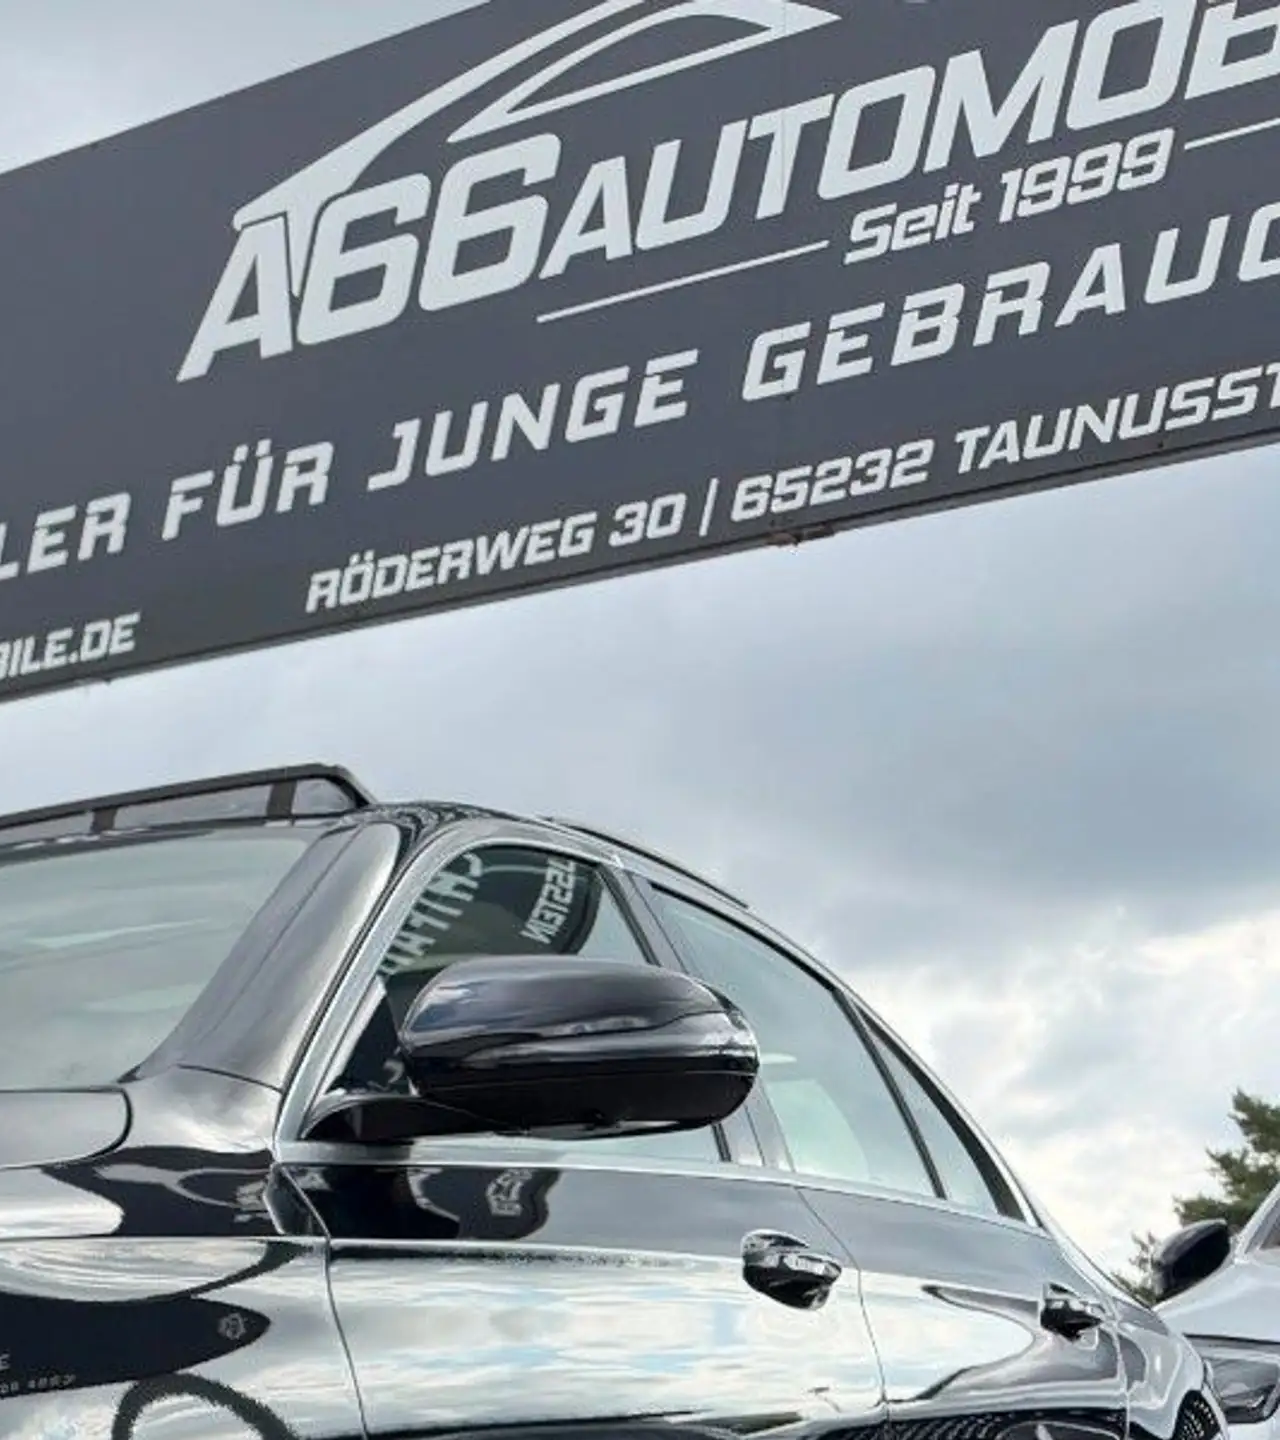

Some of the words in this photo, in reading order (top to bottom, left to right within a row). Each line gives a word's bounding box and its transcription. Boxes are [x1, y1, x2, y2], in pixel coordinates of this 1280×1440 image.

[844, 182, 982, 265] Seit
[998, 127, 1175, 224] 1999
[161, 438, 334, 541] FÜR
[367, 348, 699, 491] JUNGE
[305, 511, 598, 613] RÖDERWEG
[608, 493, 688, 547] 30
[731, 438, 936, 533] 65232
